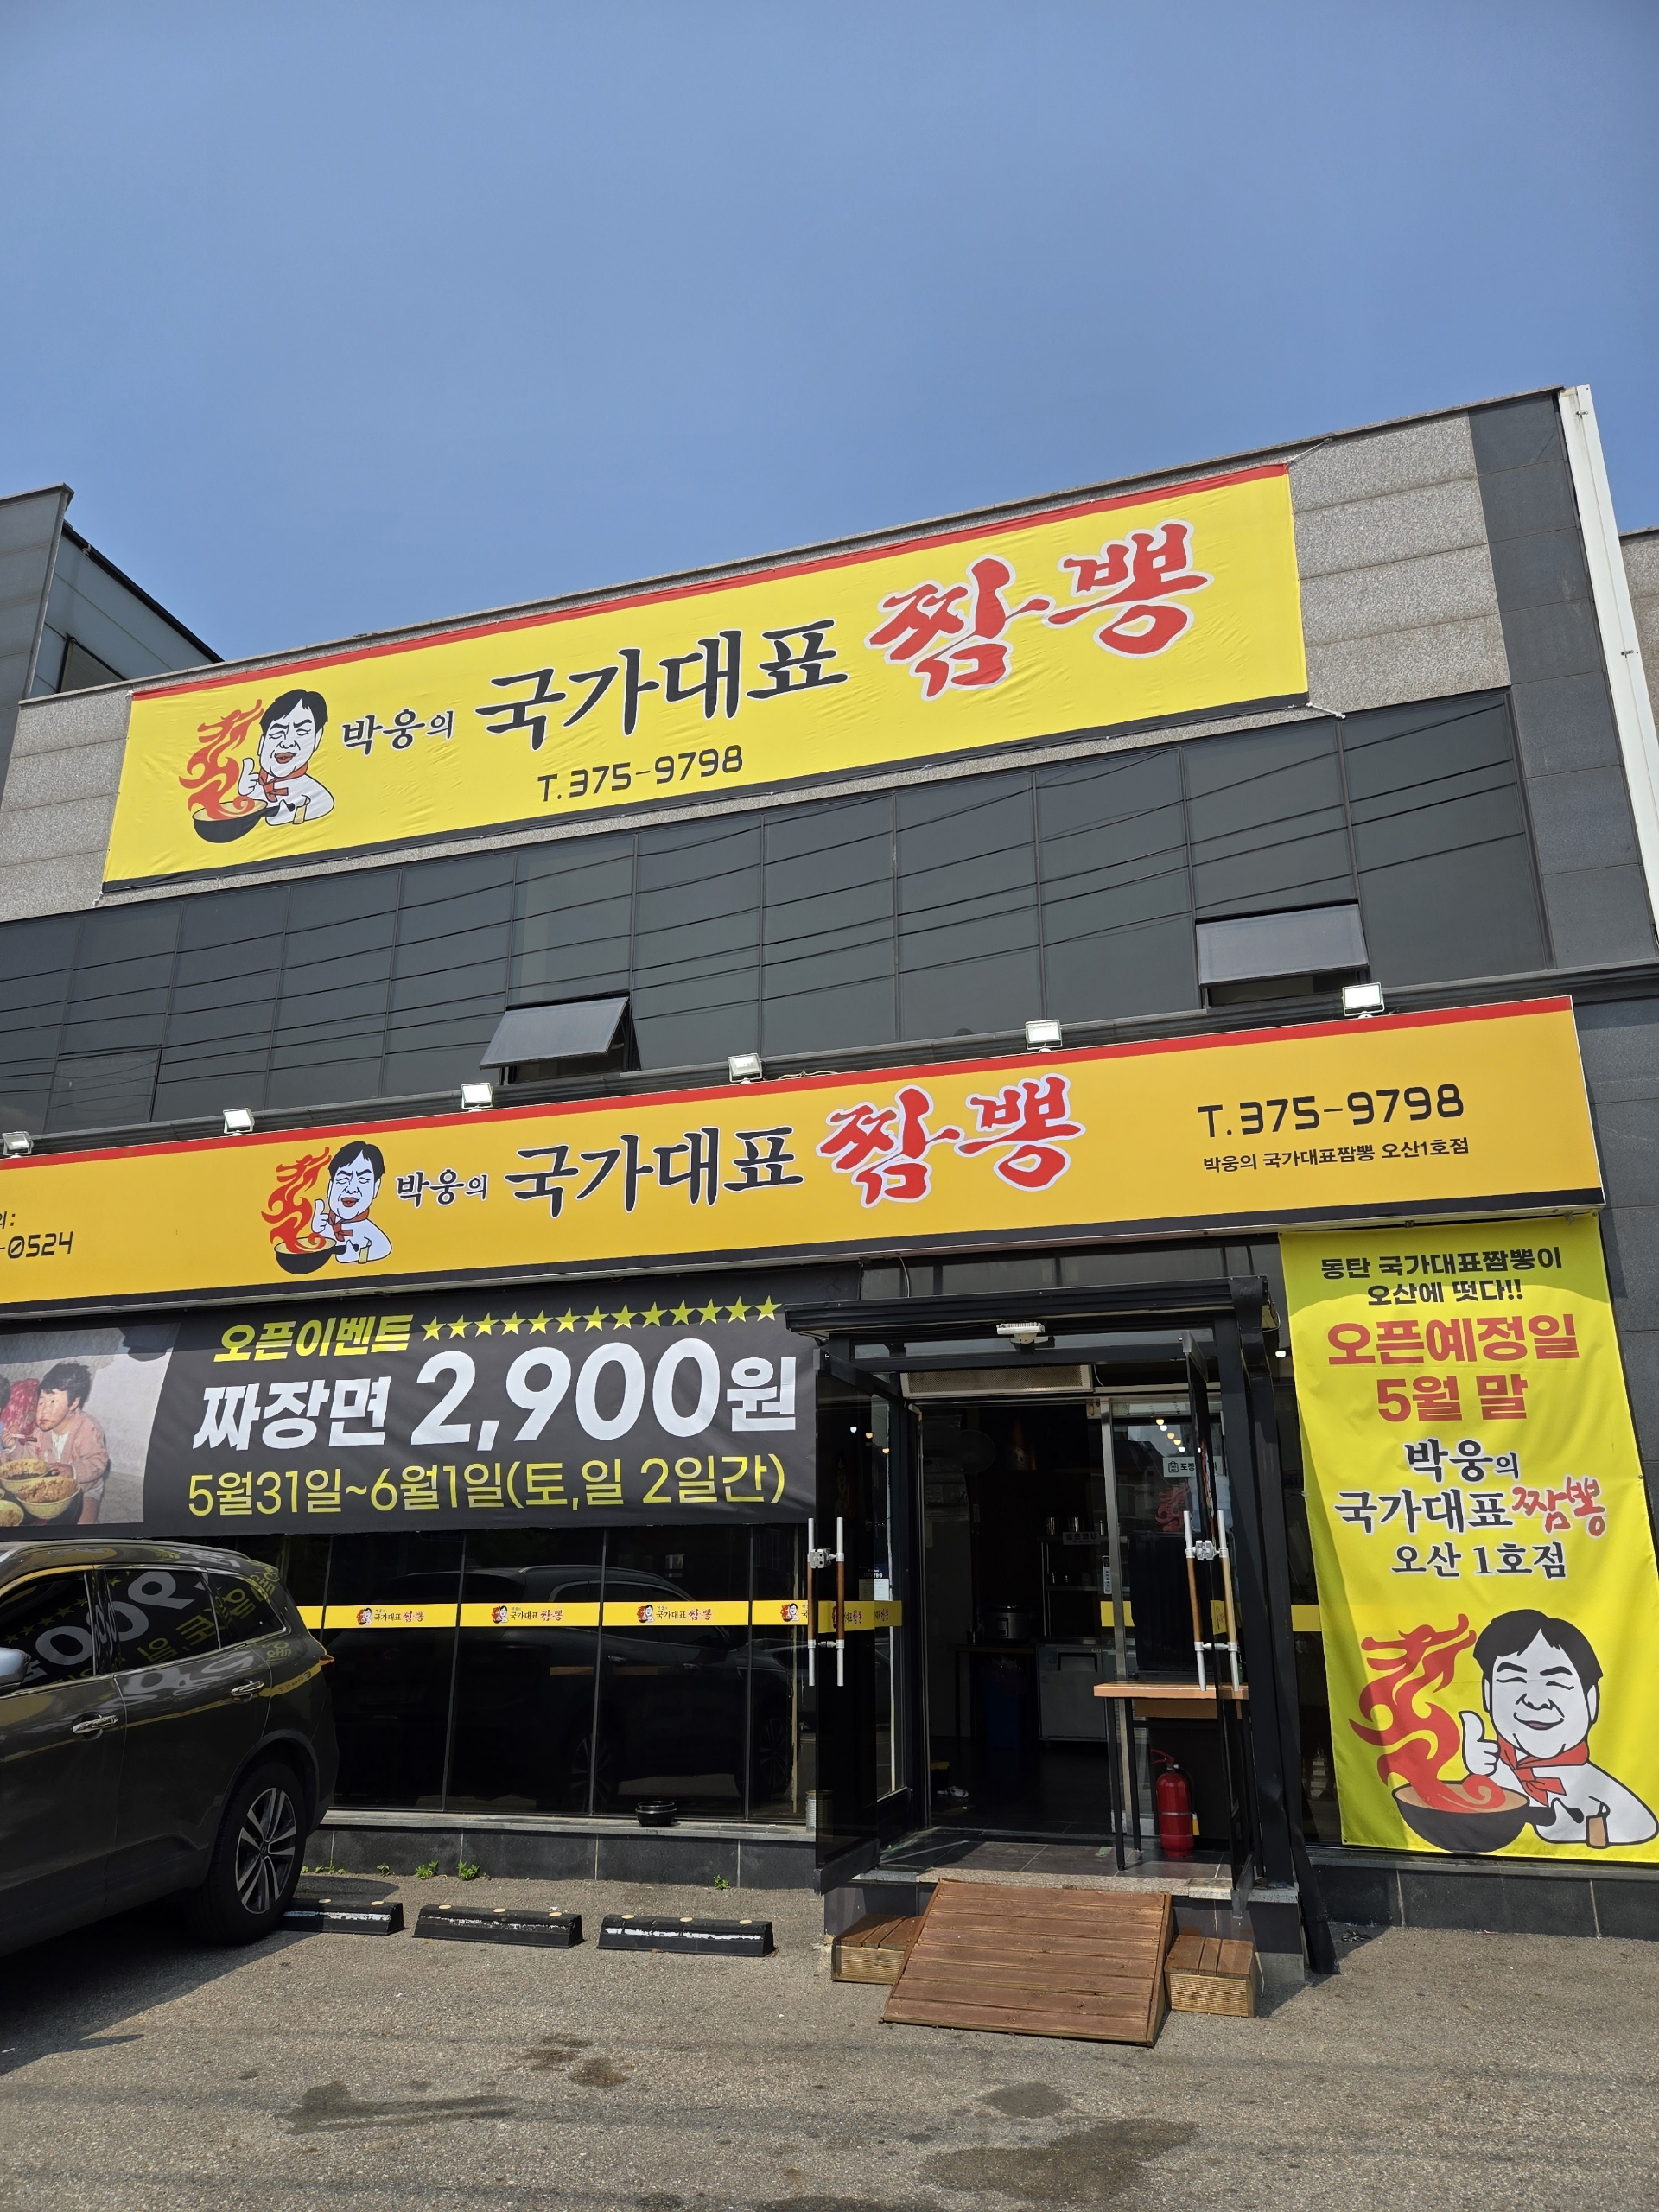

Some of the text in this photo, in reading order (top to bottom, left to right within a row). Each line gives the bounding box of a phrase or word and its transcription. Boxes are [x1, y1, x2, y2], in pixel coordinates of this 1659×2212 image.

[342, 521, 1211, 755] 박웅의 국가대표 짬뽕
[537, 744, 743, 802] T.375-9798
[1197, 1083, 1465, 1138] T.375-9798
[396, 1074, 1084, 1218] 박웅의 국가대표 짬뽕
[1203, 1136, 1470, 1173] 박웅의 국가대표짬뽕 오산1호점
[1320, 1246, 1563, 1281] 동탄 국가대표짬뽕이
[1367, 1278, 1524, 1306] 오산에 떳다!!
[213, 1313, 415, 1363] 오픈이벤트
[1326, 1313, 1580, 1366] 오픈예정일
[192, 1337, 798, 1452] 짜장면 2,900원
[1376, 1372, 1529, 1423] 5월 말
[639, 1452, 785, 1504] 2일간)
[1403, 1438, 1520, 1483] 박웅의
[1390, 1541, 1567, 1580] 오산 1호점
[373, 1612, 402, 1622] 국가대표
[510, 1611, 538, 1621] 국가대표
[656, 1610, 687, 1620] 국가대표
